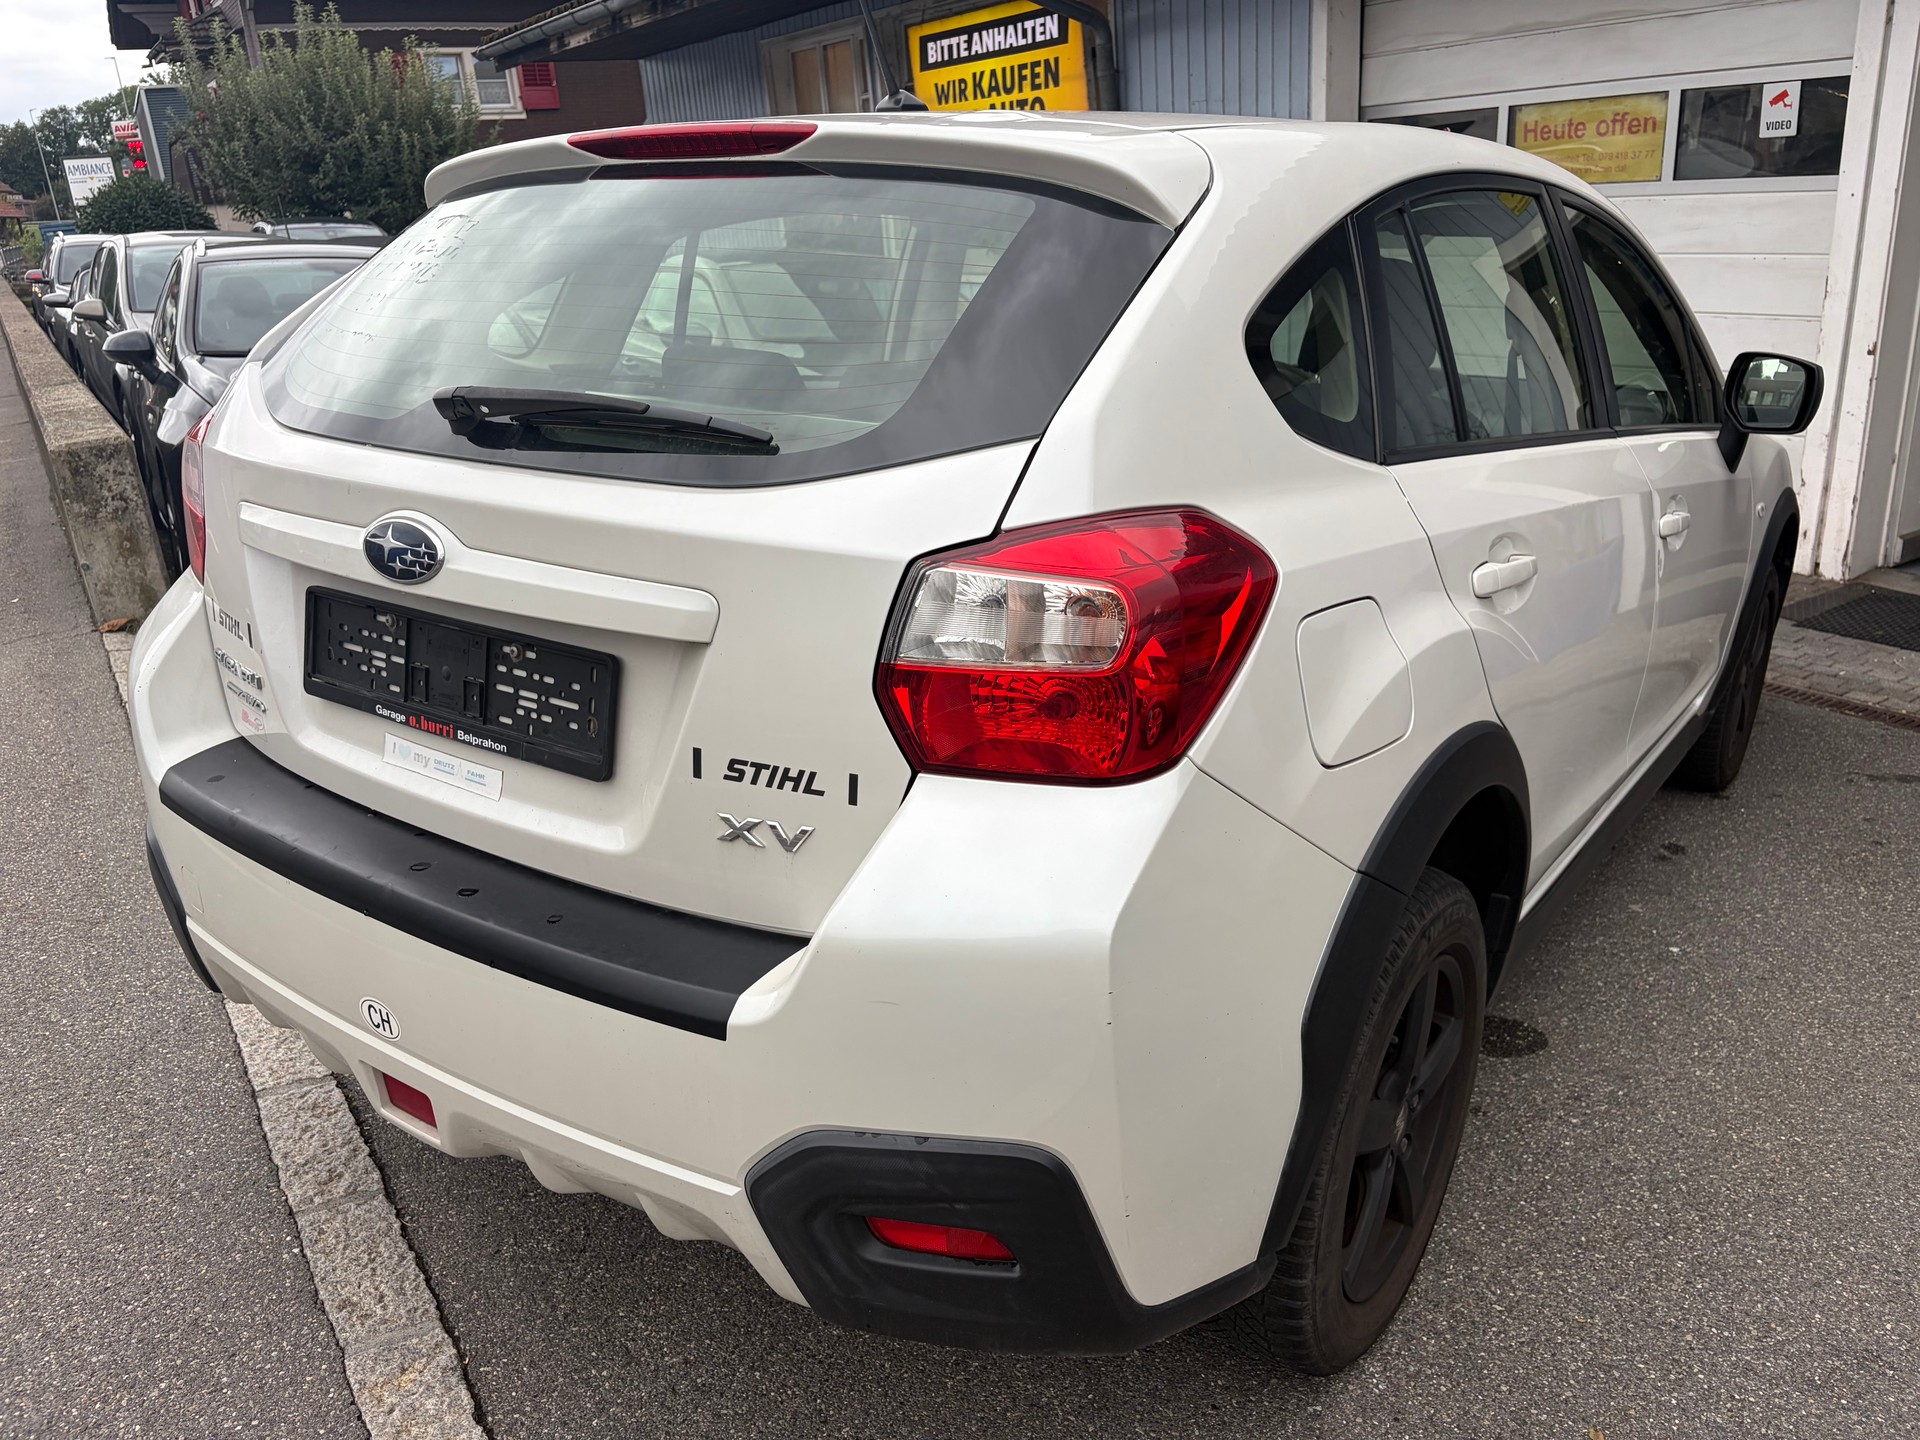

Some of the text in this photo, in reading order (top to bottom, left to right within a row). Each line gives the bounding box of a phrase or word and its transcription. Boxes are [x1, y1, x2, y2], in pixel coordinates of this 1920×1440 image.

[927, 13, 1059, 64] BITTE ANHALTEN
[934, 56, 1060, 106] WIR KAUFEN
[1523, 112, 1657, 143] Heute offen
[1765, 119, 1792, 131] VIDEO
[67, 162, 113, 177] AMBIANCE
[218, 607, 244, 641] STIHL
[375, 704, 507, 753] Garage o.burri Belprahon
[413, 751, 431, 768] my
[434, 758, 456, 770] DEUTZ
[467, 769, 486, 781] FAHR
[722, 758, 826, 797] STIHL
[716, 811, 816, 853] XV
[367, 1004, 394, 1036] CH
